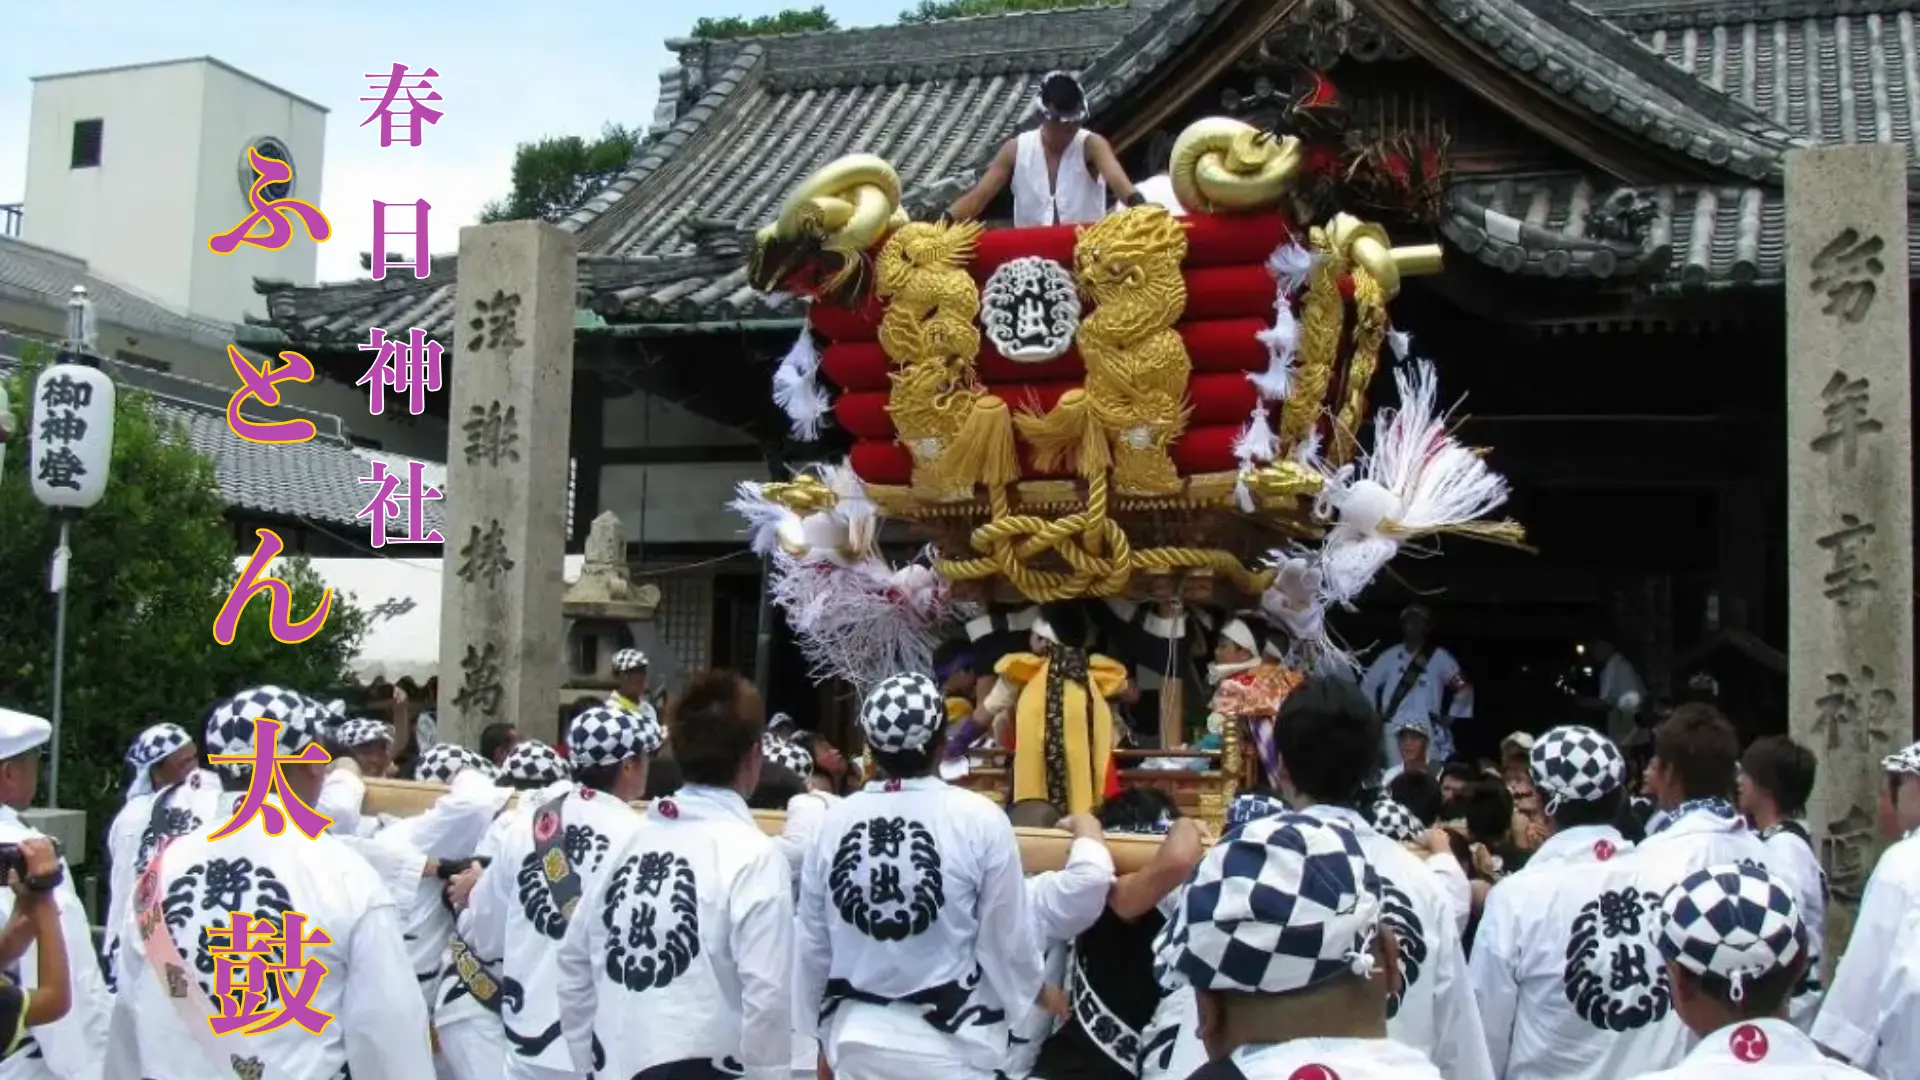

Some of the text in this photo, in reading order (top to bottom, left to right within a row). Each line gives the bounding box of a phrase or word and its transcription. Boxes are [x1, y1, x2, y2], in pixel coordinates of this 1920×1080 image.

[1011, 259, 1049, 338] 野出
[628, 851, 674, 950] 野出
[868, 816, 905, 905] 野出
[1599, 886, 1651, 991] 野出
